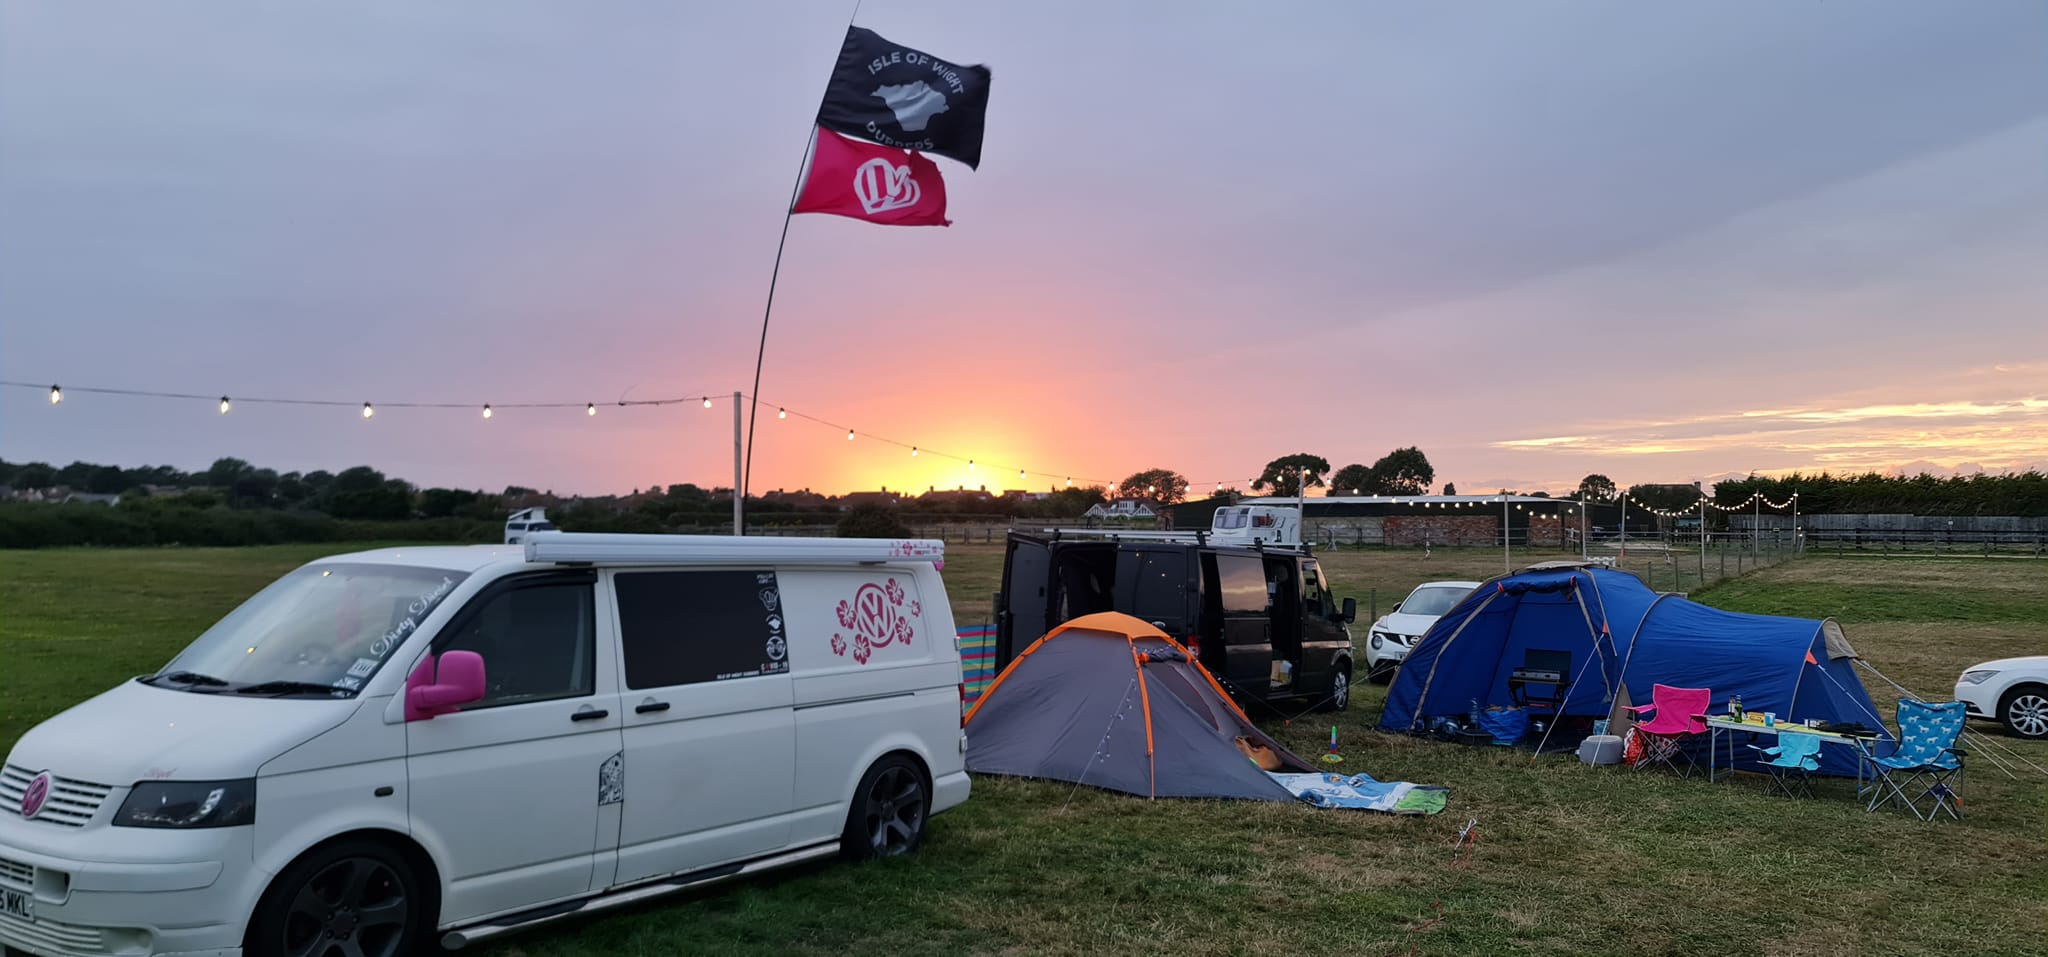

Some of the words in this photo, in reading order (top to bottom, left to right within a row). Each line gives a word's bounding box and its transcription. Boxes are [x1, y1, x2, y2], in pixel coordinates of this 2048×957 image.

[868, 51, 901, 75] ISLE
[906, 52, 929, 66] OF
[932, 62, 964, 95] WIGHT
[370, 616, 417, 658] Dirty
[6, 892, 30, 917] MKL
